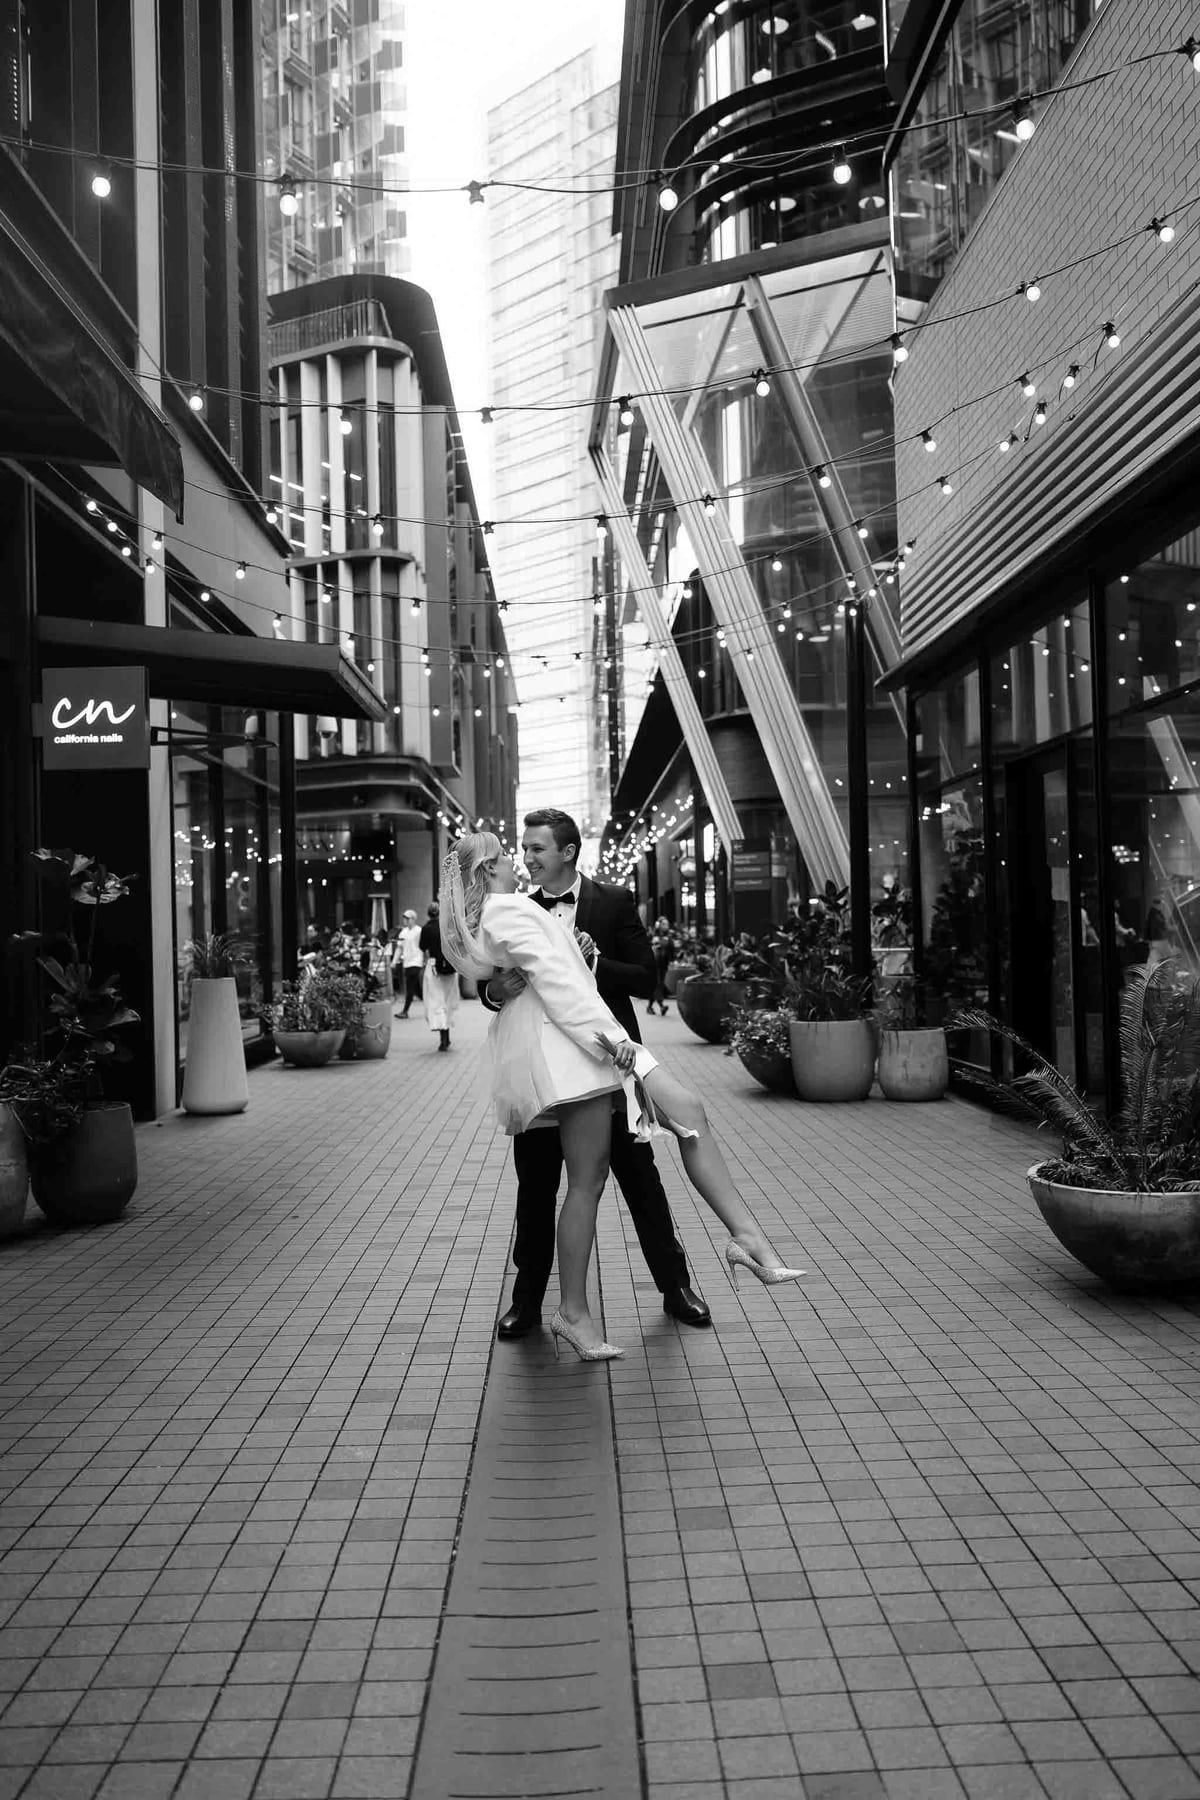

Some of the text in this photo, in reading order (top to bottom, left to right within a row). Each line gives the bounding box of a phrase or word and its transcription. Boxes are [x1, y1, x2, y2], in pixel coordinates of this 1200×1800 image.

[52, 698, 136, 729] cn
[54, 733, 124, 744] california nails
